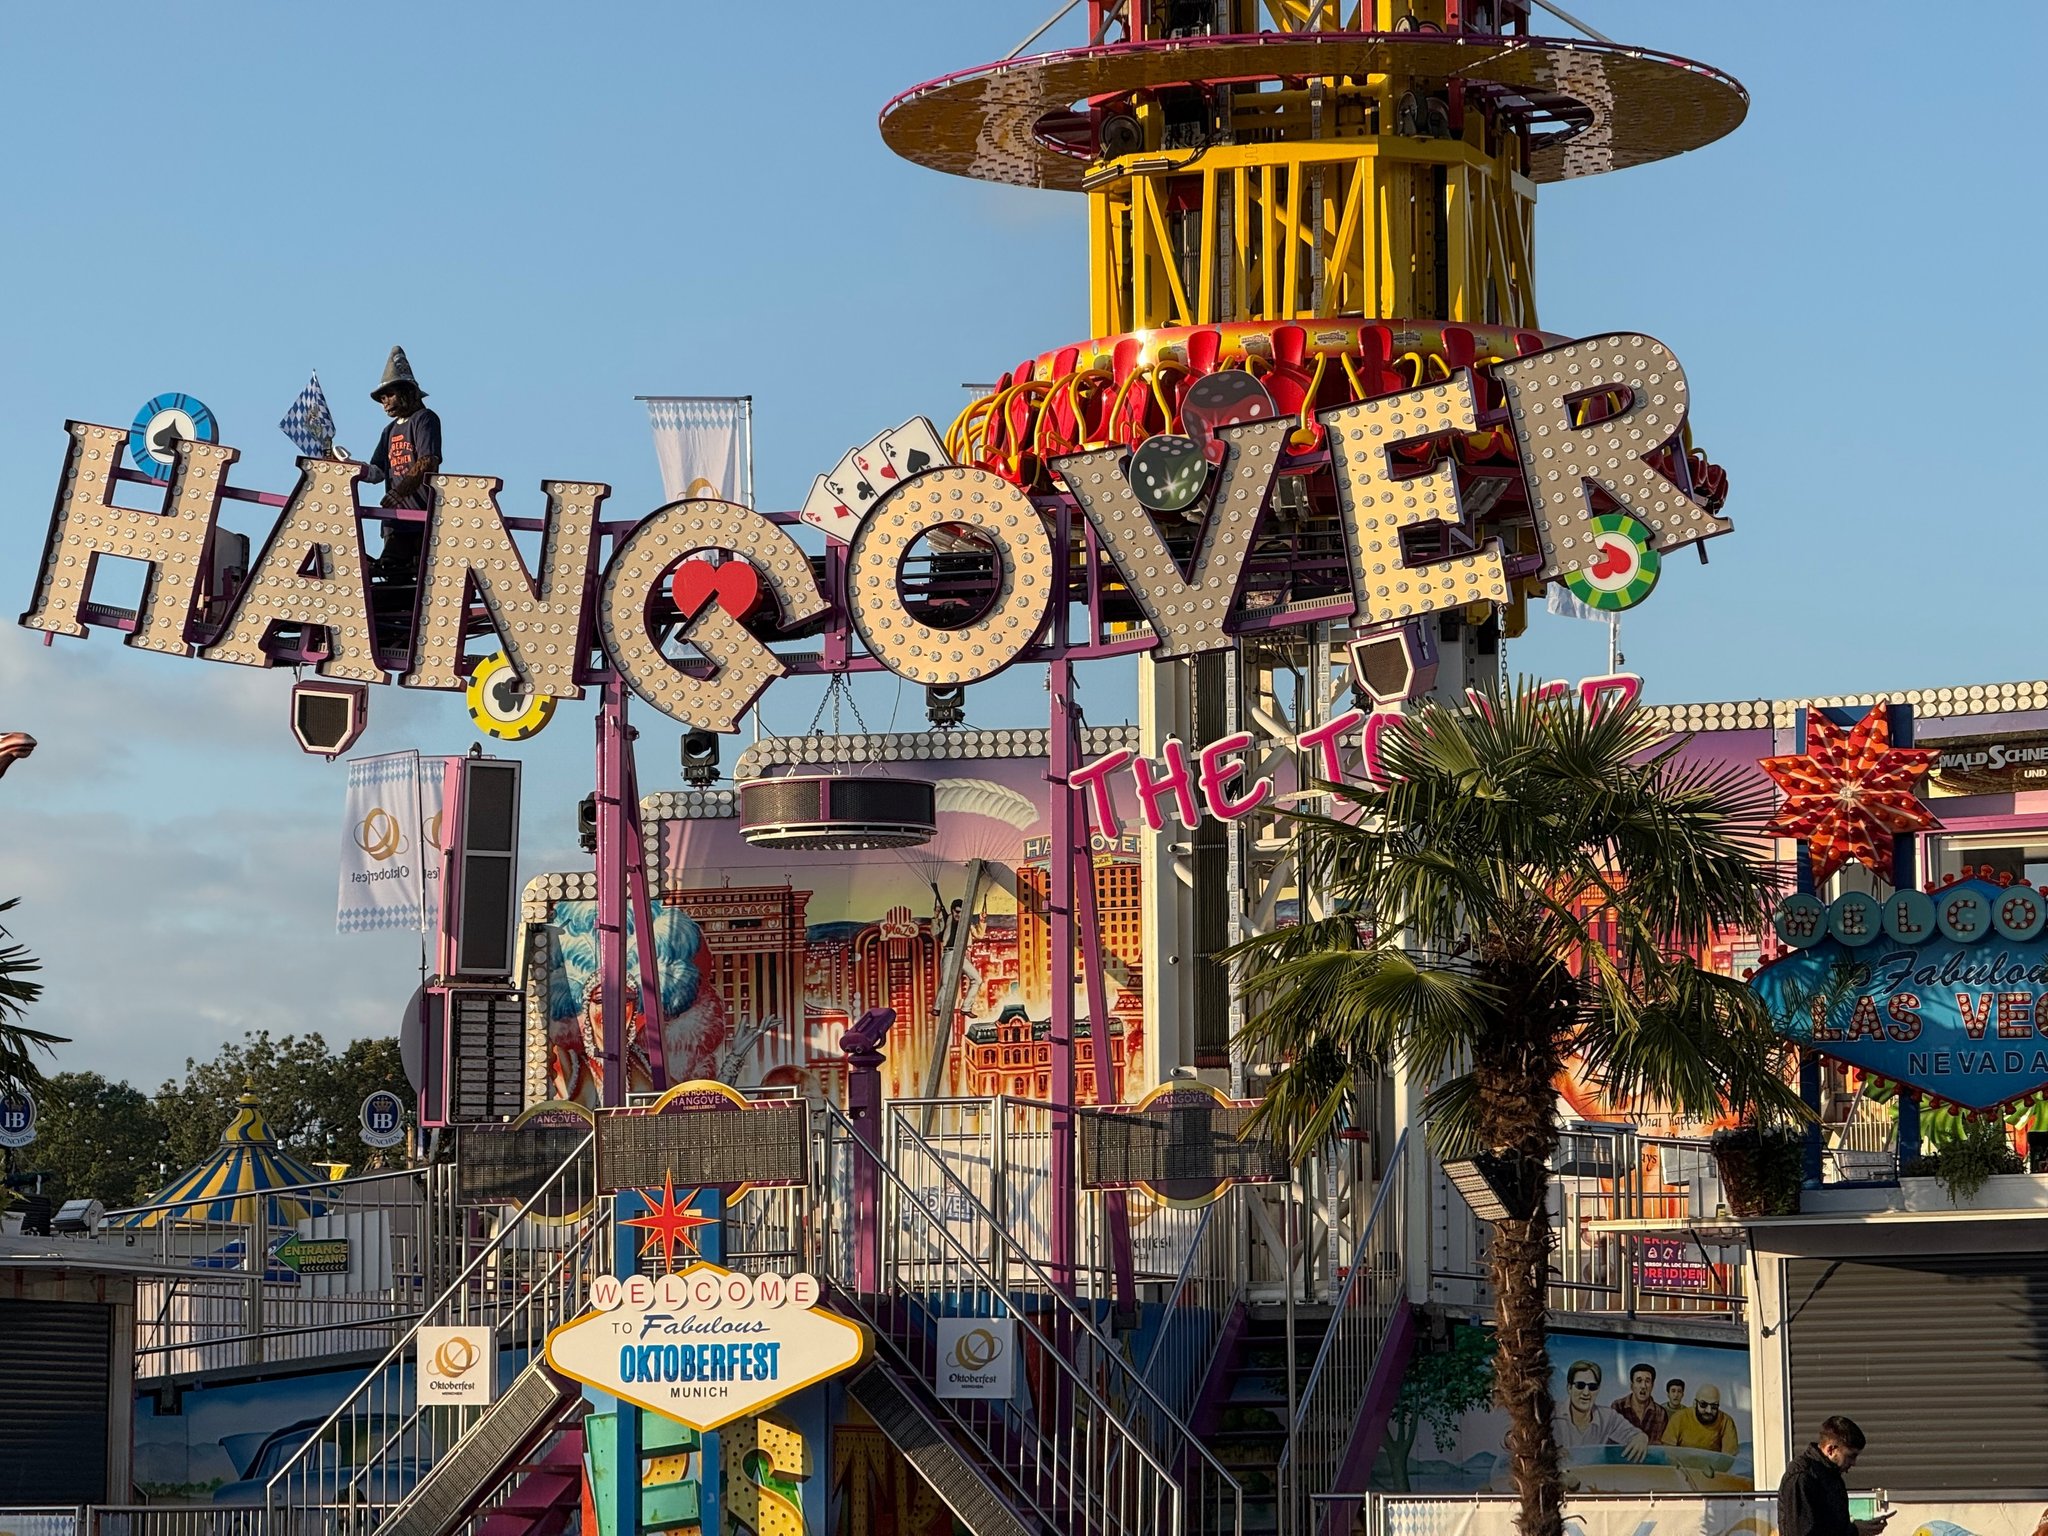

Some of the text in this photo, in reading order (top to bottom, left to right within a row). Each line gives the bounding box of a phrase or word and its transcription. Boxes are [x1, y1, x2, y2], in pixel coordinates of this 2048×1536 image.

[885, 442, 894, 452] A
[857, 456, 867, 466] A
[829, 481, 839, 491] A
[805, 511, 816, 522] A
[19, 331, 1734, 735] HANGOVER
[1932, 752, 1988, 772] WALD
[2024, 768, 2047, 778] UND
[1068, 731, 1272, 839] THE
[686, 906, 717, 917] SARS
[1812, 992, 1923, 1043] LAS
[1908, 1050, 2048, 1076] NEVADA
[671, 1095, 728, 1106] HANGOVER
[1155, 1094, 1212, 1105] HANGOVER
[372, 1113, 393, 1129] HB
[530, 1114, 583, 1124] HANGOVER
[284, 1244, 349, 1257] ENTRANCE
[299, 1254, 347, 1266] EINGANG
[595, 1281, 810, 1304] WELCOME
[611, 1314, 771, 1341] TO Fabulous
[619, 1342, 781, 1383] OKTOBERFEST
[949, 1373, 997, 1385] Oktoberfest
[429, 1380, 475, 1393] Oktoberfest
[670, 1386, 729, 1399] MUNICH
